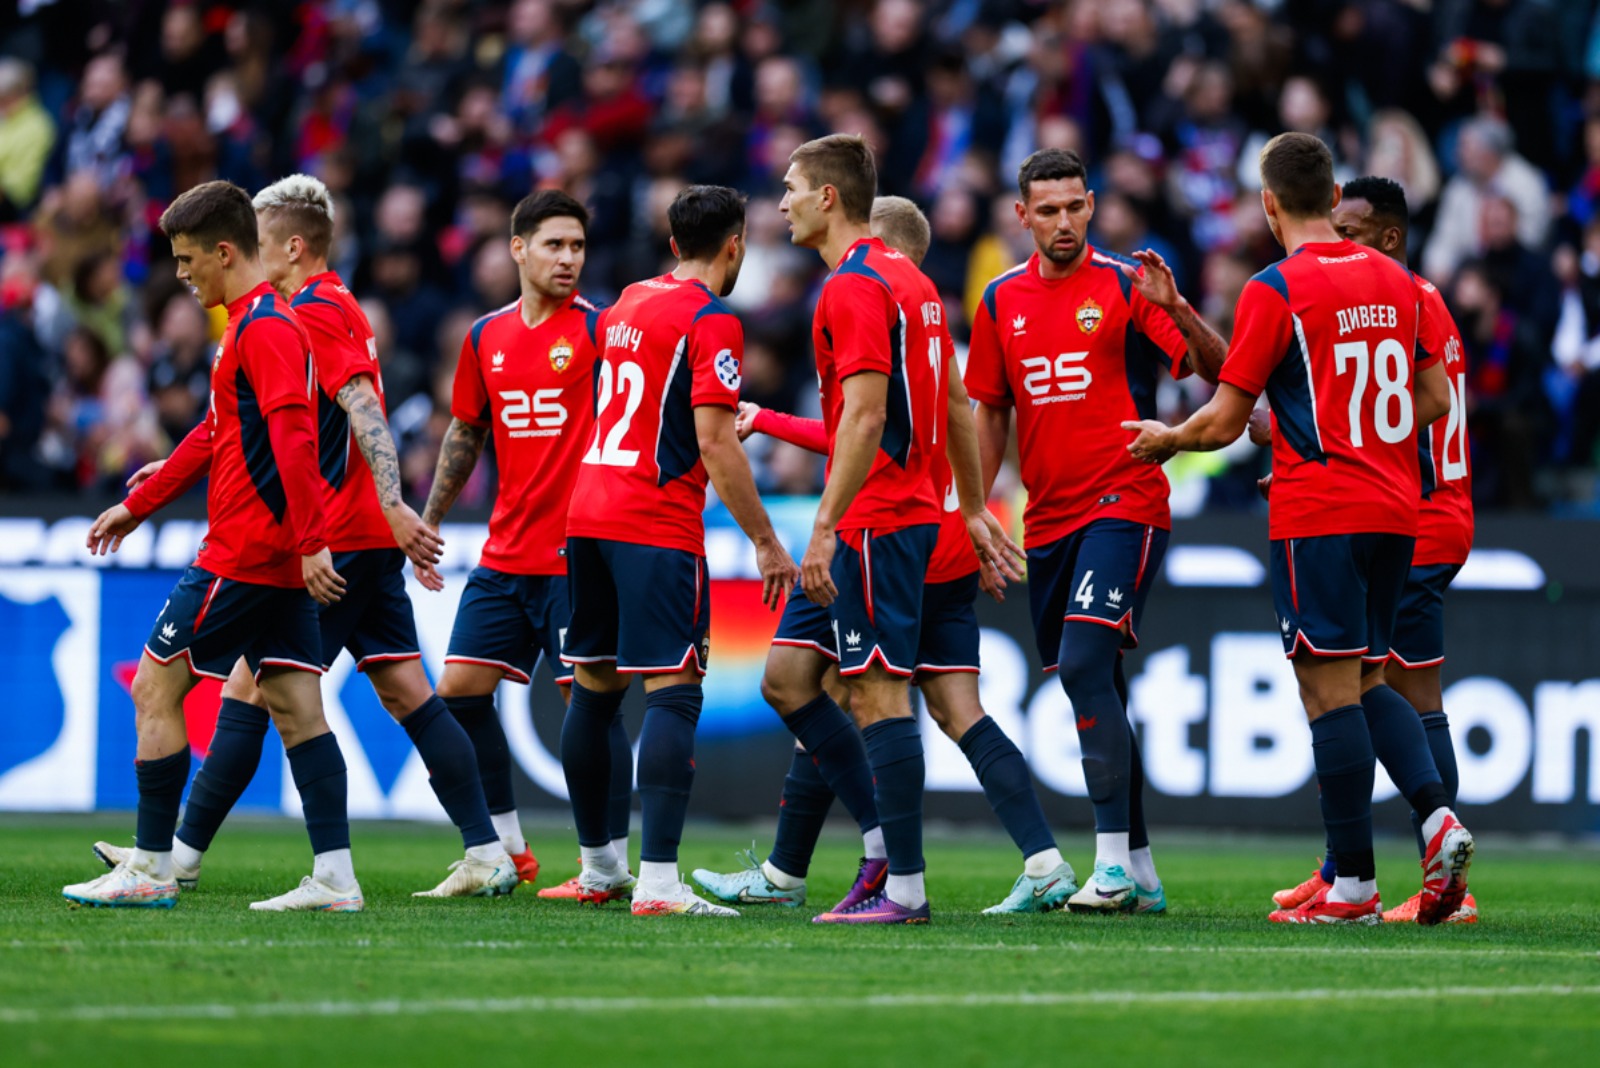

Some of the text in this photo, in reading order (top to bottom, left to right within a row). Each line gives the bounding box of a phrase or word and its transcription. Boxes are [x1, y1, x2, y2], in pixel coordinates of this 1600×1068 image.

[1336, 304, 1398, 336] ДИВЕЕВ
[1020, 351, 1093, 396] 25
[1333, 338, 1414, 448] 78
[498, 388, 568, 429] 25
[1075, 570, 1095, 609] 4
